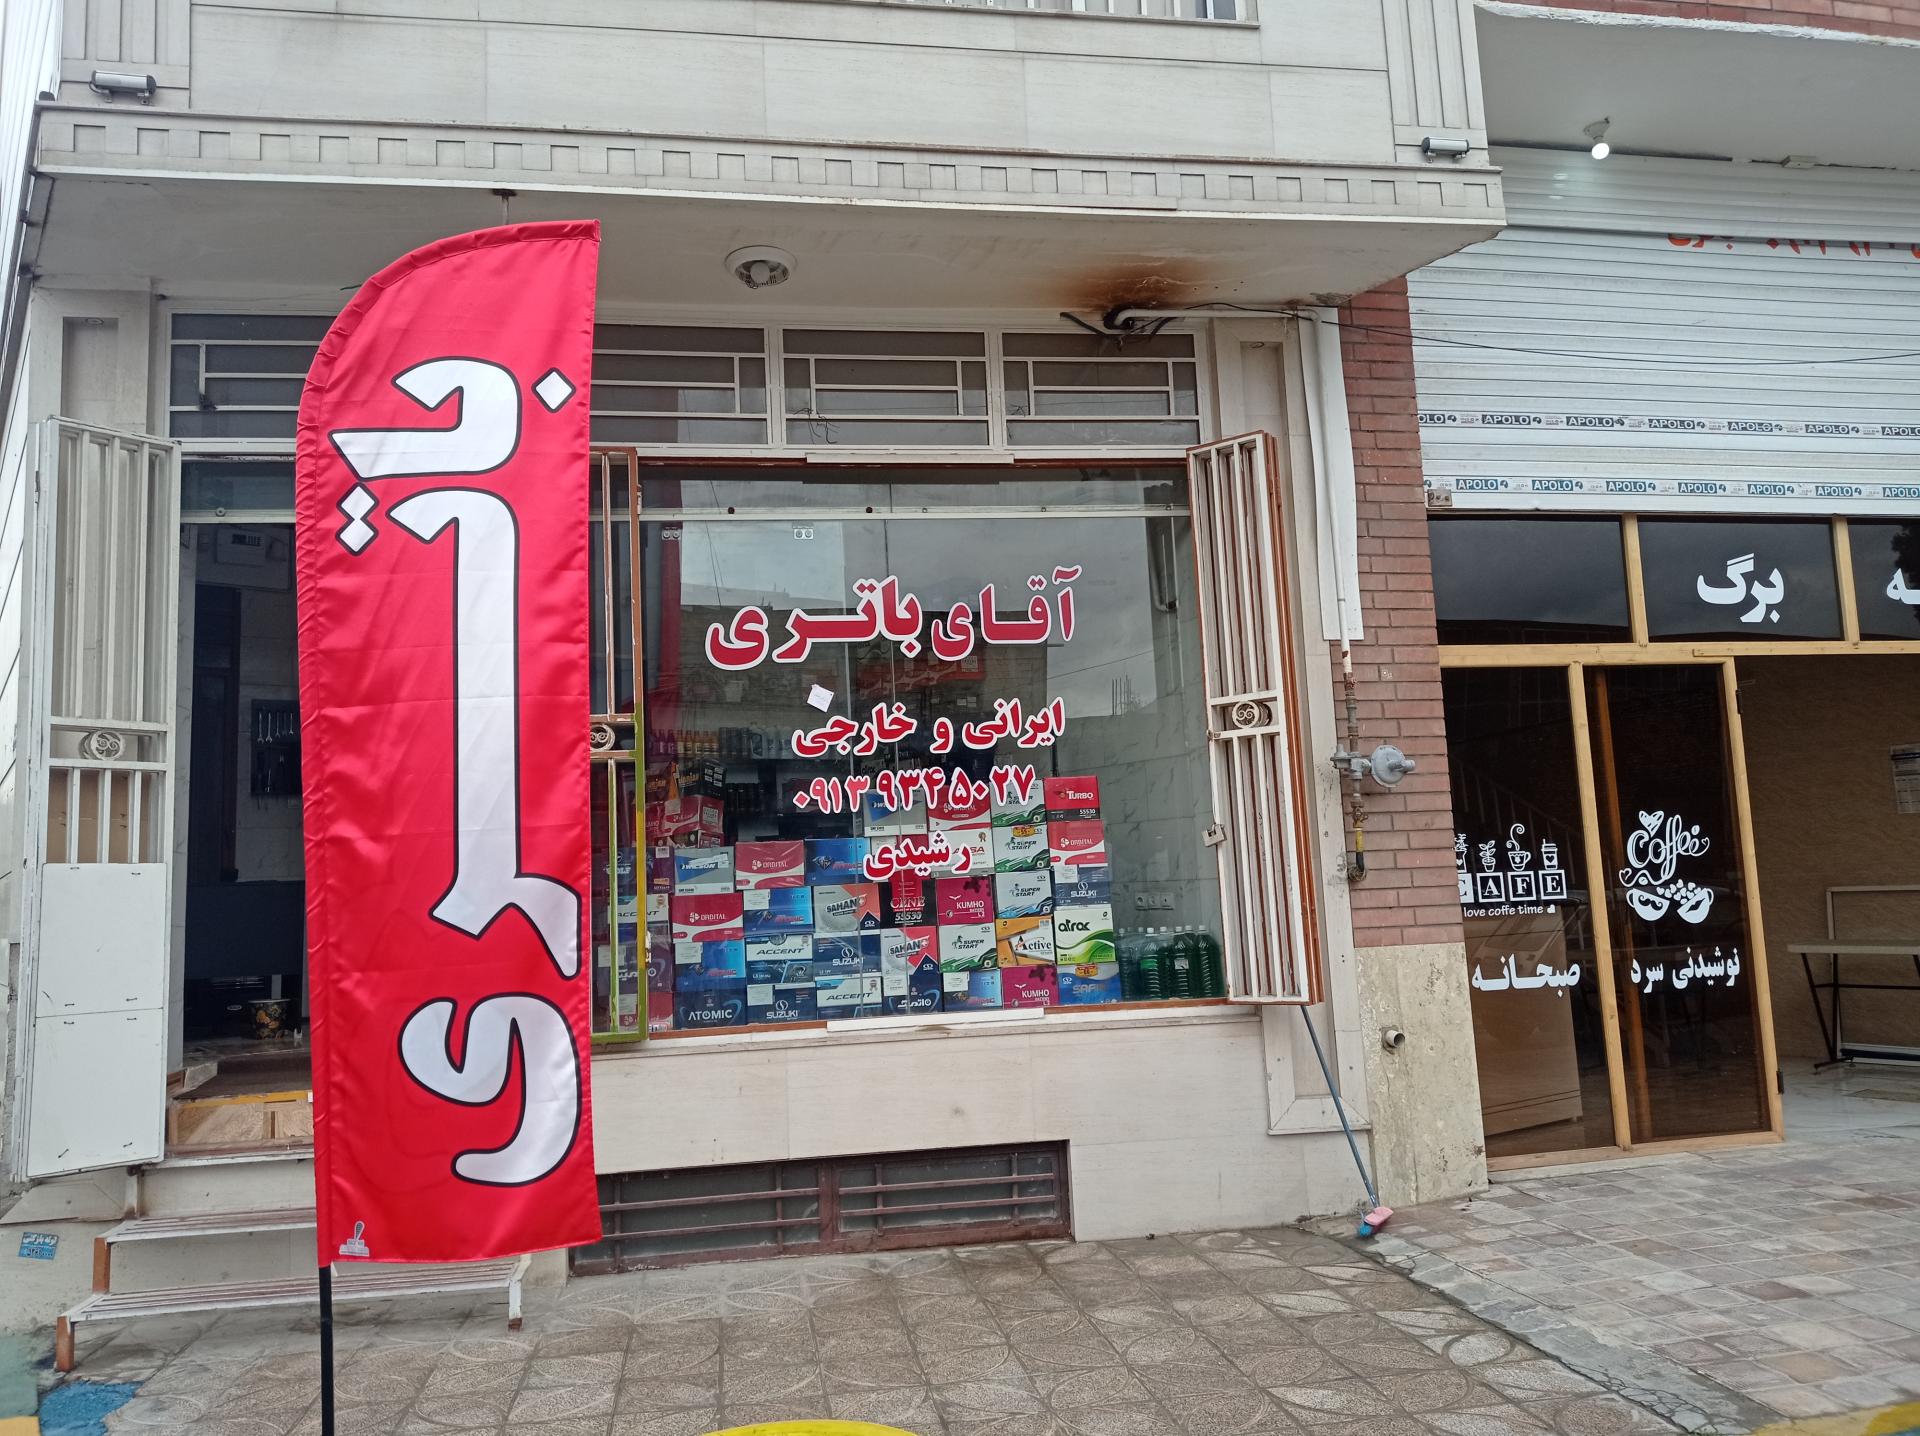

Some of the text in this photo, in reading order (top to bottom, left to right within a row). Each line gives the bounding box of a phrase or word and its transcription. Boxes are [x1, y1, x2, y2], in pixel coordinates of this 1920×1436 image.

[1418, 414, 1445, 424] OLO
[1483, 414, 1530, 425] APOLO
[1568, 416, 1613, 427] APOLO
[1651, 419, 1694, 430] APOLO
[1730, 422, 1773, 432] APOLO
[1807, 425, 1849, 435] APOLO
[1458, 479, 1497, 490] APOLO
[1533, 480, 1572, 491] APOLO
[1607, 481, 1645, 492] APOLO
[1679, 483, 1717, 493] APOLO
[1748, 485, 1785, 495] APOLO
[1816, 486, 1853, 497] APOLO
[1884, 487, 1919, 498] APOLO
[1696, 552, 1785, 624] برگ
[705, 564, 1083, 671] آقای باتری
[791, 696, 1067, 757] ایرانی و خارجی
[328, 355, 579, 1188] باتری
[863, 829, 973, 882] رشیدی
[1070, 890, 1097, 898] SUZUKI
[956, 900, 985, 909] KUMHO
[1463, 903, 1545, 917] love coffe time
[700, 913, 727, 921] ORBITAL
[1014, 935, 1053, 952] Active
[832, 957, 865, 967] SUZUKI
[1630, 945, 1741, 994] نوشیدنی سرد
[1471, 953, 1581, 998] صبحانه
[1021, 989, 1050, 999] KUMHO
[688, 1009, 733, 1021] ATOMIC
[765, 1009, 799, 1020] SUZUKI
